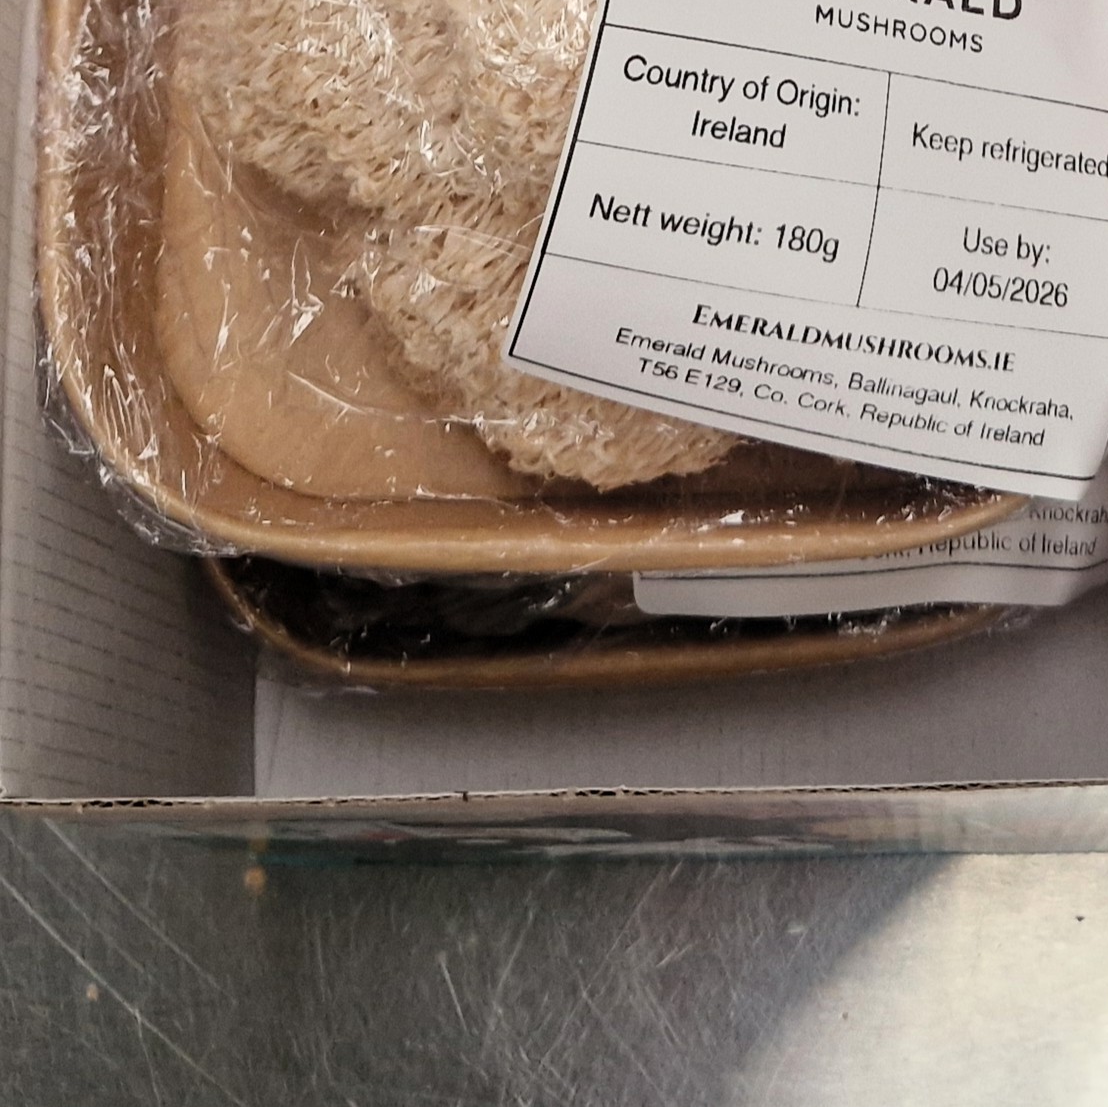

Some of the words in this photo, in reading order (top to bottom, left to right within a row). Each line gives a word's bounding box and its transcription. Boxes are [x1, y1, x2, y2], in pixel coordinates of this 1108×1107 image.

[815, 3, 983, 54] MUSHROOMS
[623, 53, 736, 104] Country
[742, 74, 771, 103] of
[776, 78, 861, 119] Origin:
[691, 109, 787, 150] Ireland
[912, 121, 974, 163] Keep
[588, 192, 653, 228] Nett
[660, 211, 763, 247] weight:
[775, 223, 840, 264] 180g
[962, 225, 1009, 258] Use
[1016, 233, 1051, 269] by:
[932, 266, 1069, 309] 04/05/2026
[691, 303, 1016, 373] EMERALDMUSHROOMS.IE
[615, 326, 707, 362] Emerald
[710, 346, 839, 390] Mushrooms,
[847, 371, 961, 409] Ballinagaul,
[969, 388, 1074, 422] Knockraha,
[638, 356, 679, 381] T56
[753, 383, 788, 405] Co.
[797, 391, 851, 419] Cork,
[859, 402, 947, 434] Republic
[953, 419, 975, 438] of
[979, 422, 1046, 447] Ireland
[1018, 532, 1037, 554] of
[1041, 533, 1096, 556] Ireland
